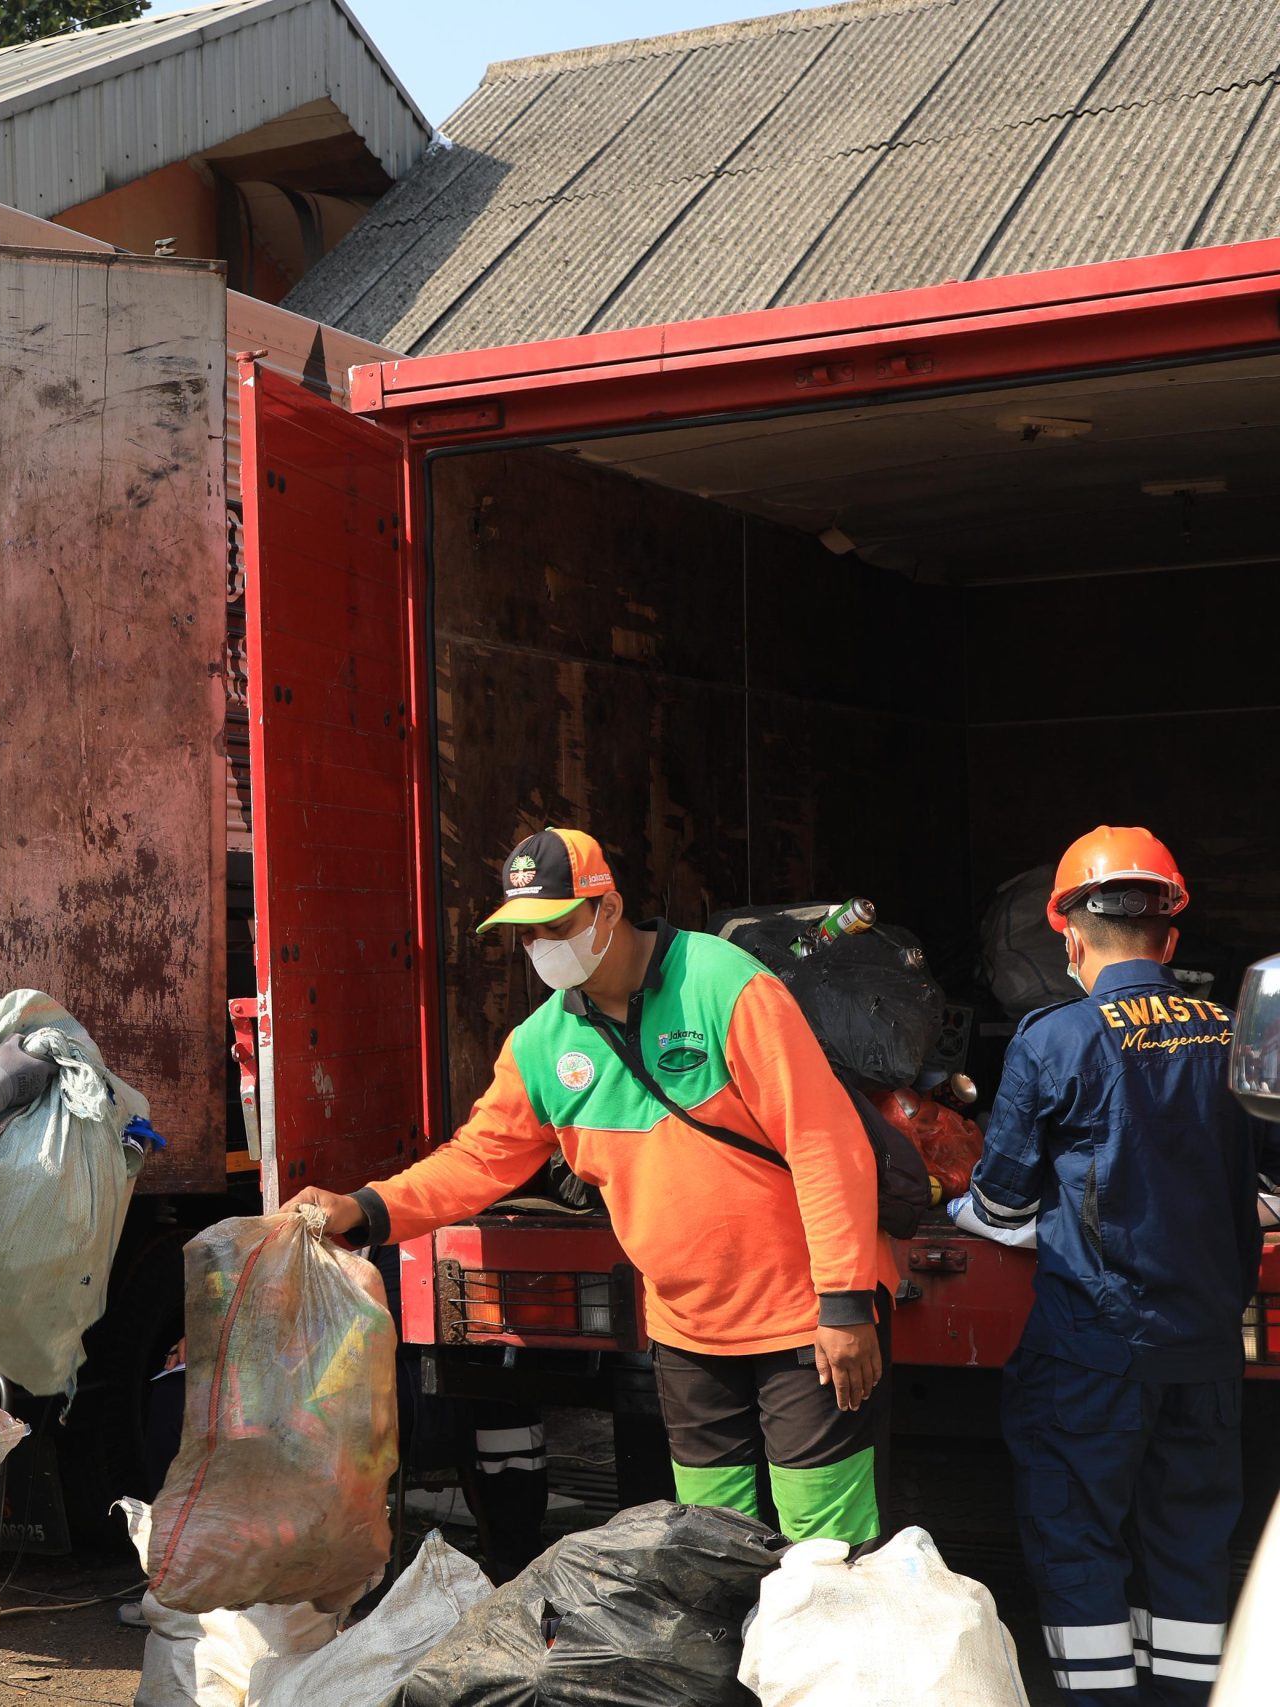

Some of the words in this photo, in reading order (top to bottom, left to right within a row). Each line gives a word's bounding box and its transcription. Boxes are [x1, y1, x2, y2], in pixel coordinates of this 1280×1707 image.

[1099, 995, 1230, 1028] EWASTE
[669, 1029, 704, 1041] Jakarta
[1121, 1027, 1234, 1054] Management
